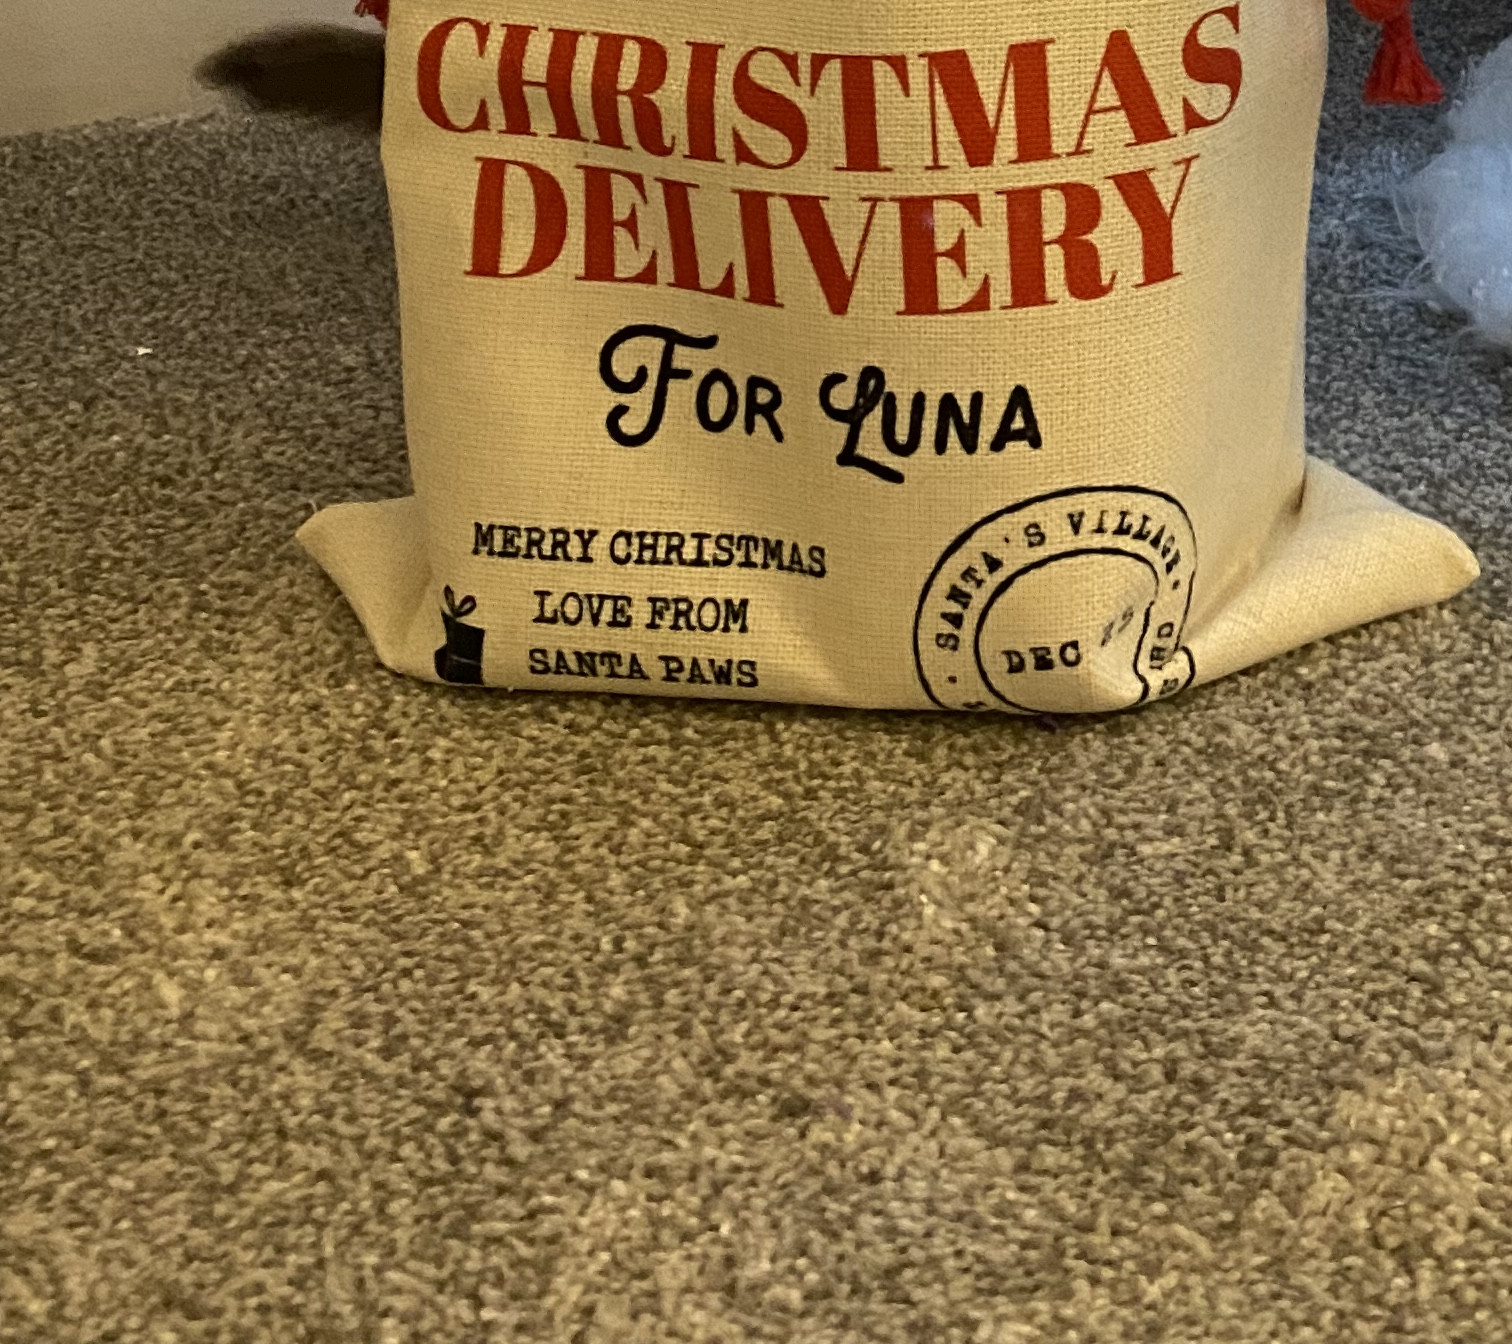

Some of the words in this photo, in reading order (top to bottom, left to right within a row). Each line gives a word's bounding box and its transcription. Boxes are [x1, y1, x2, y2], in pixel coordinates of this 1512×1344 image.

[416, 3, 1243, 172] CHRISTMAS
[465, 155, 1200, 316] DELIVERY
[819, 365, 1044, 484] LUNA
[472, 521, 597, 563] MERRY
[609, 530, 826, 578] CHRISTMAS
[532, 590, 632, 628] LOVE
[645, 595, 750, 633] FROM
[528, 648, 650, 680] SANTA
[659, 655, 759, 688] PAWS
[1002, 641, 1082, 674] DEC
